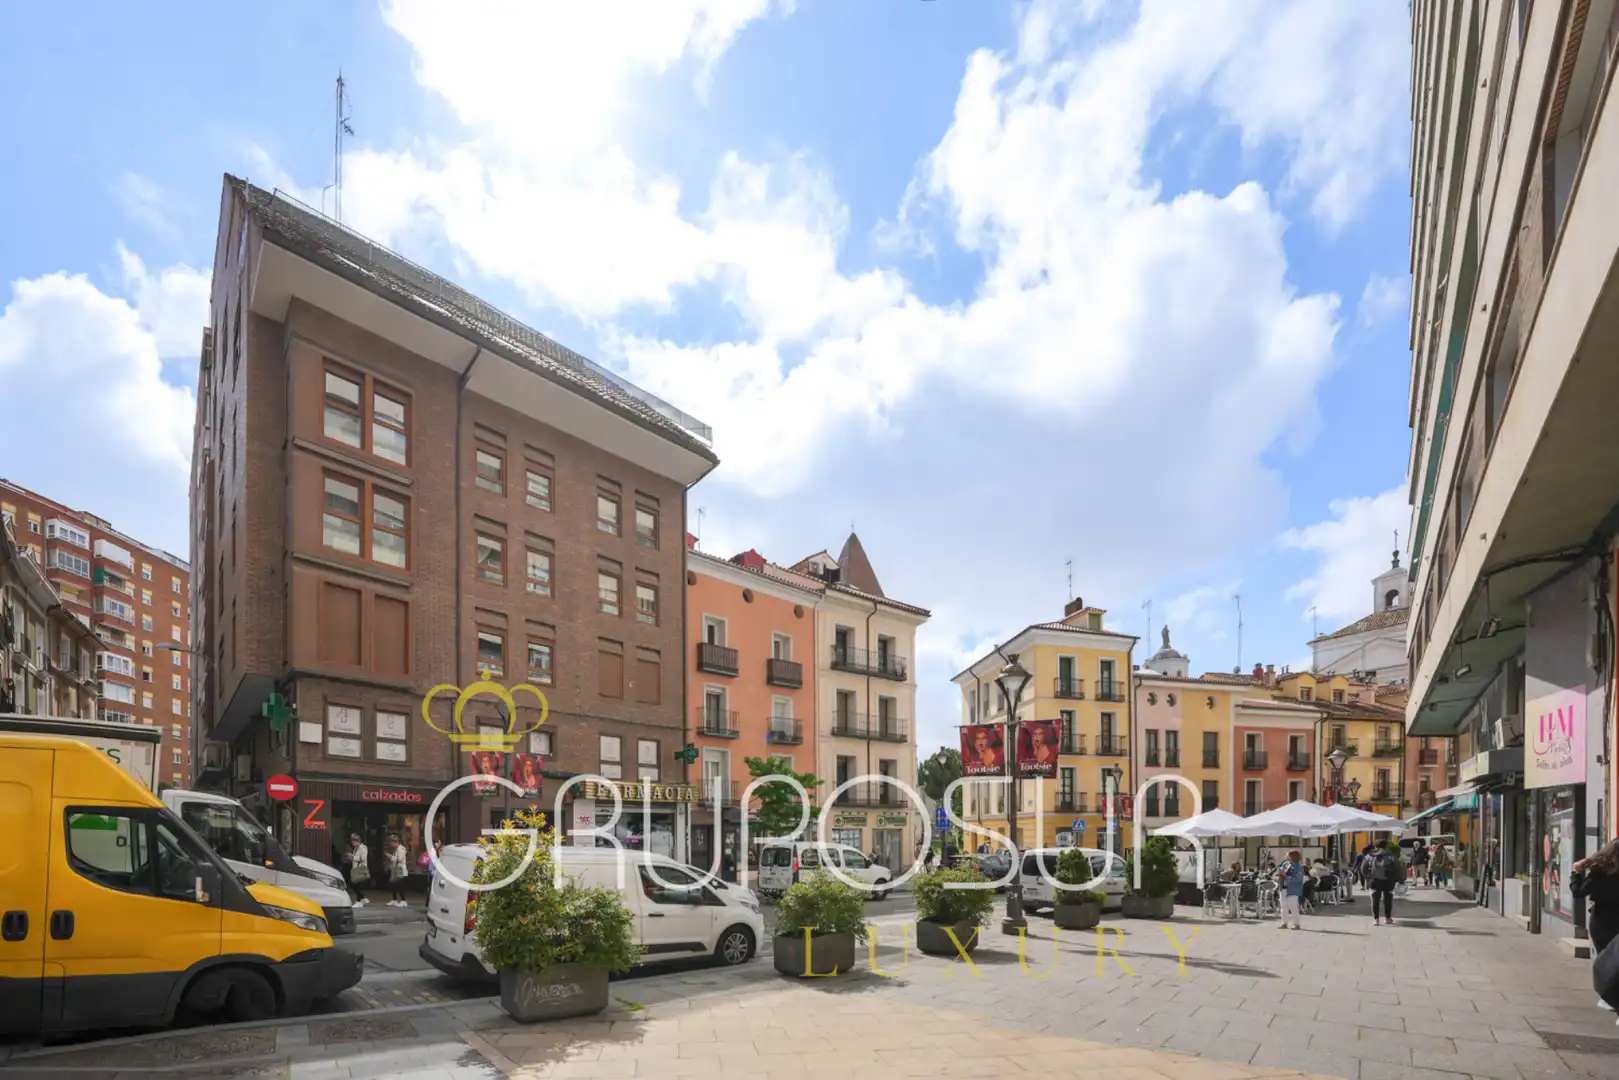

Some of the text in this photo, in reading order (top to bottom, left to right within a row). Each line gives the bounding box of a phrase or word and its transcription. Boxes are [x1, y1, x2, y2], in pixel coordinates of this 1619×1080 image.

[966, 764, 1000, 774] Tootsie
[1020, 762, 1053, 771] Tootsie
[362, 789, 422, 802] calzados
[597, 781, 694, 800] FRMACIA
